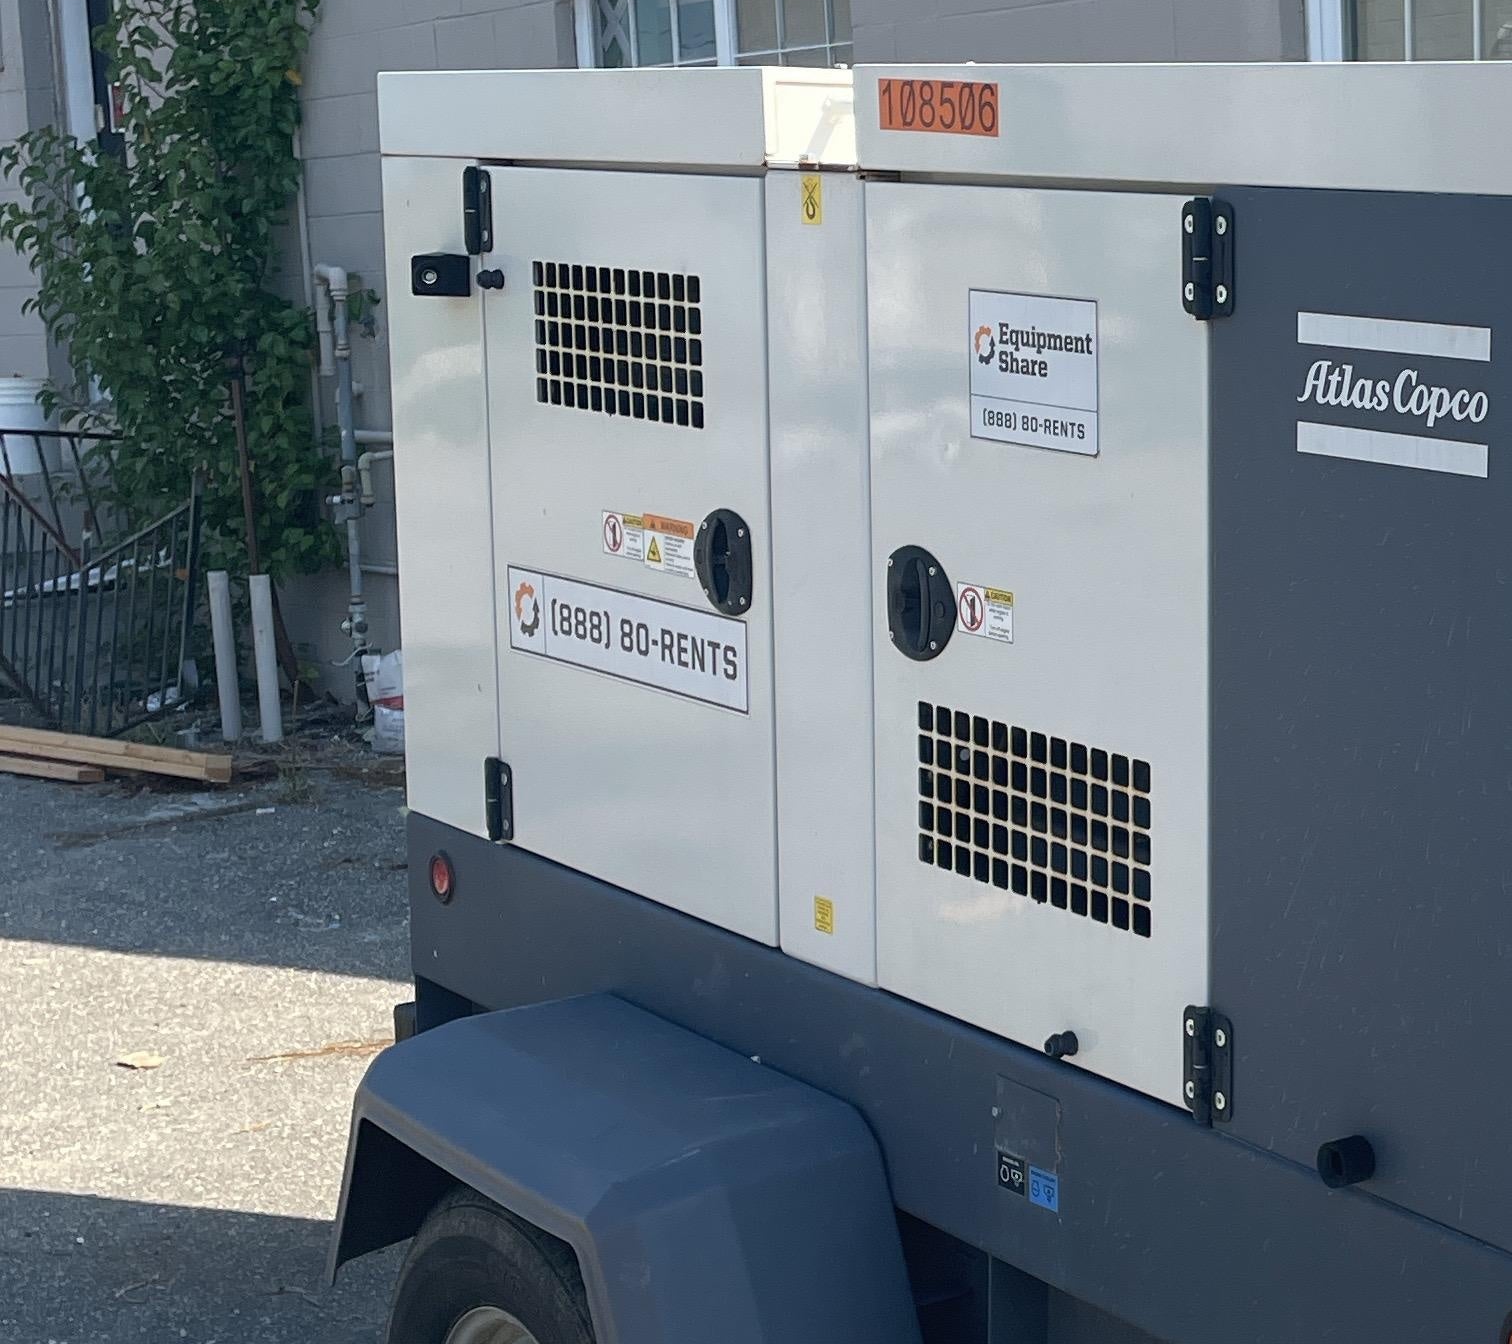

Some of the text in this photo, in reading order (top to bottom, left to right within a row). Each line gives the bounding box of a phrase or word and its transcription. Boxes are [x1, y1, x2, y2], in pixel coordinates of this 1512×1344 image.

[881, 80, 996, 132] 108506
[998, 322, 1093, 355] Equipment
[998, 350, 1048, 377] Share
[1297, 360, 1489, 427] Atlas Copco
[983, 408, 1086, 439] (888) 80-RENTS
[550, 598, 738, 681] (888) 80-RENTS
